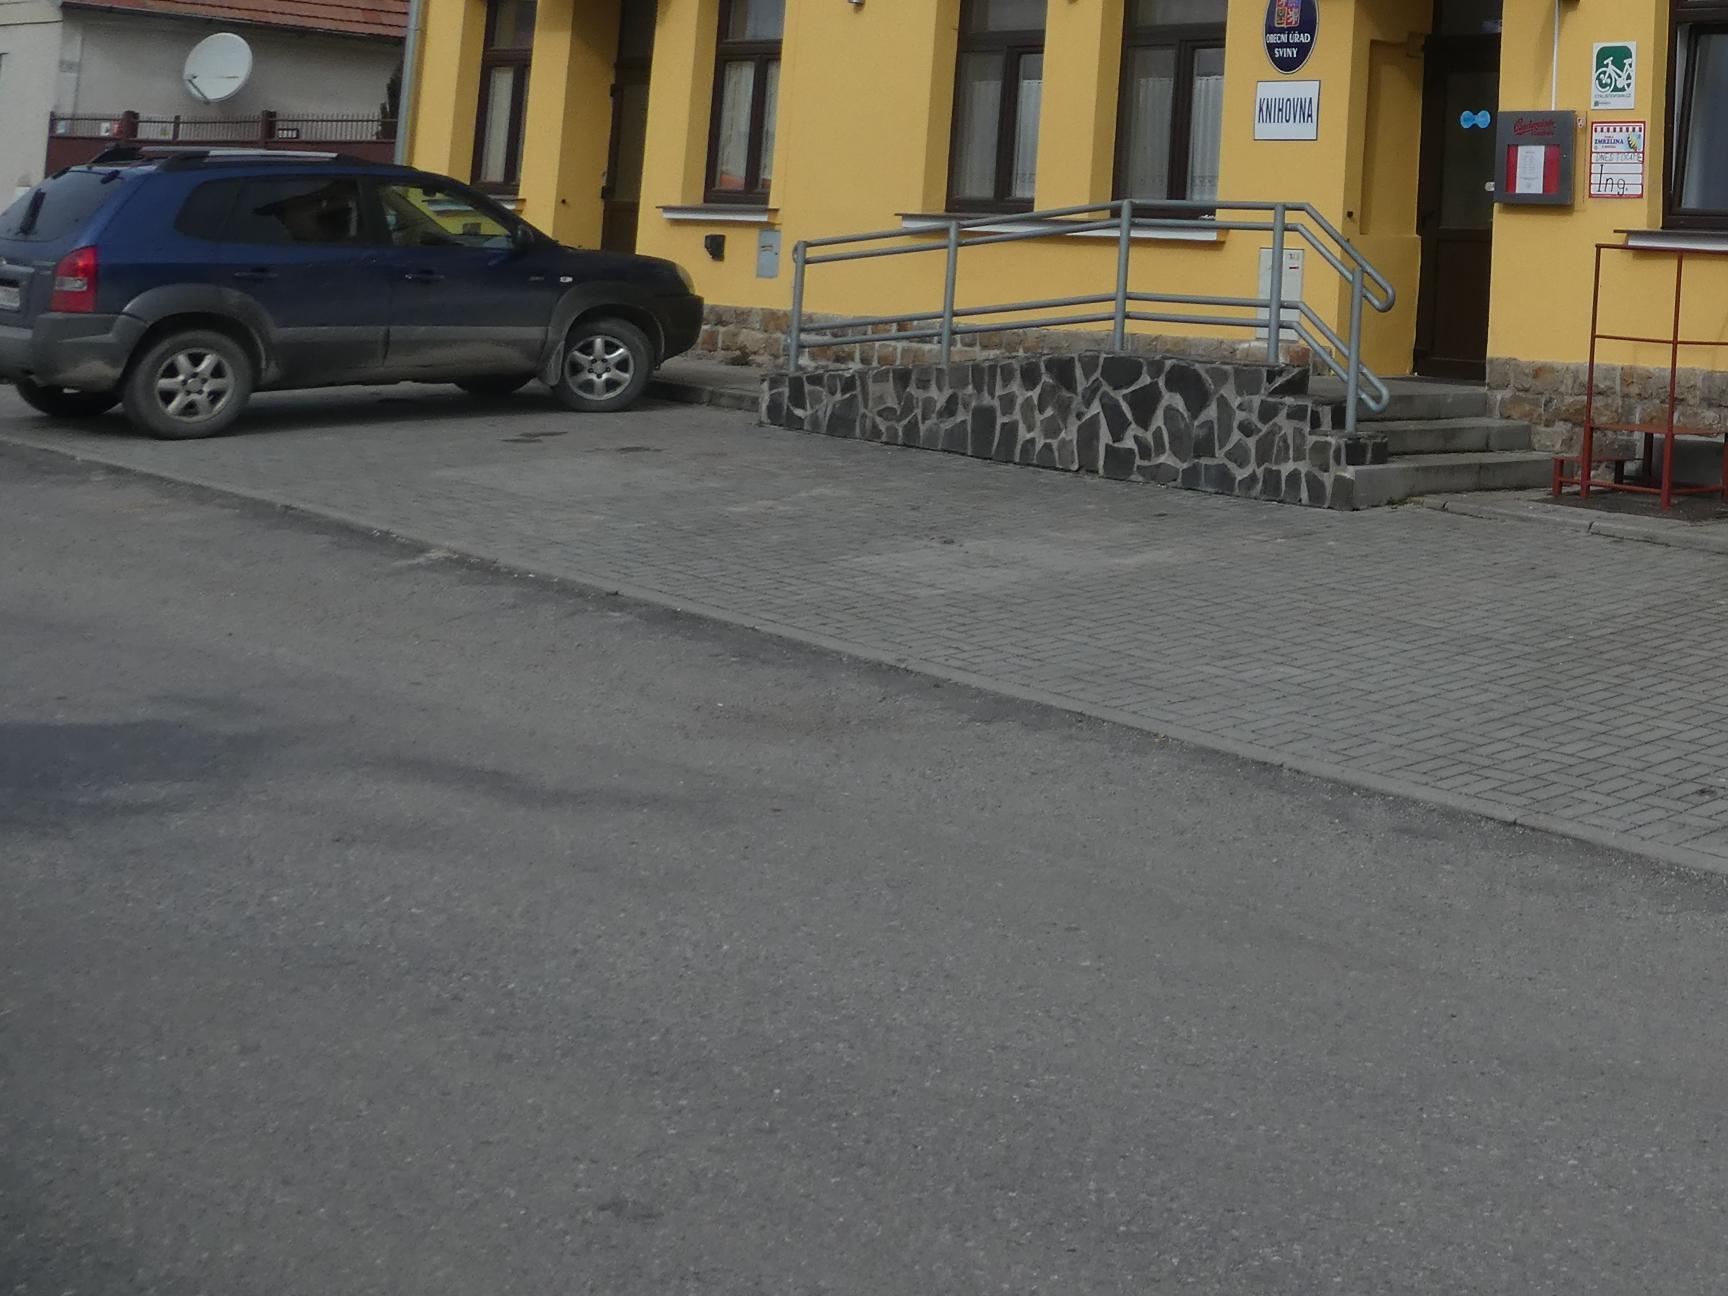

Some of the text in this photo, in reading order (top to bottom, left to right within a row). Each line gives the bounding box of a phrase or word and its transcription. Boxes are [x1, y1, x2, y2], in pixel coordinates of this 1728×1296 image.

[1266, 31, 1311, 43] OBECNÍ ÚŘAD
[1274, 47, 1298, 58] SVINY
[1258, 97, 1313, 124] KNIHOVNA
